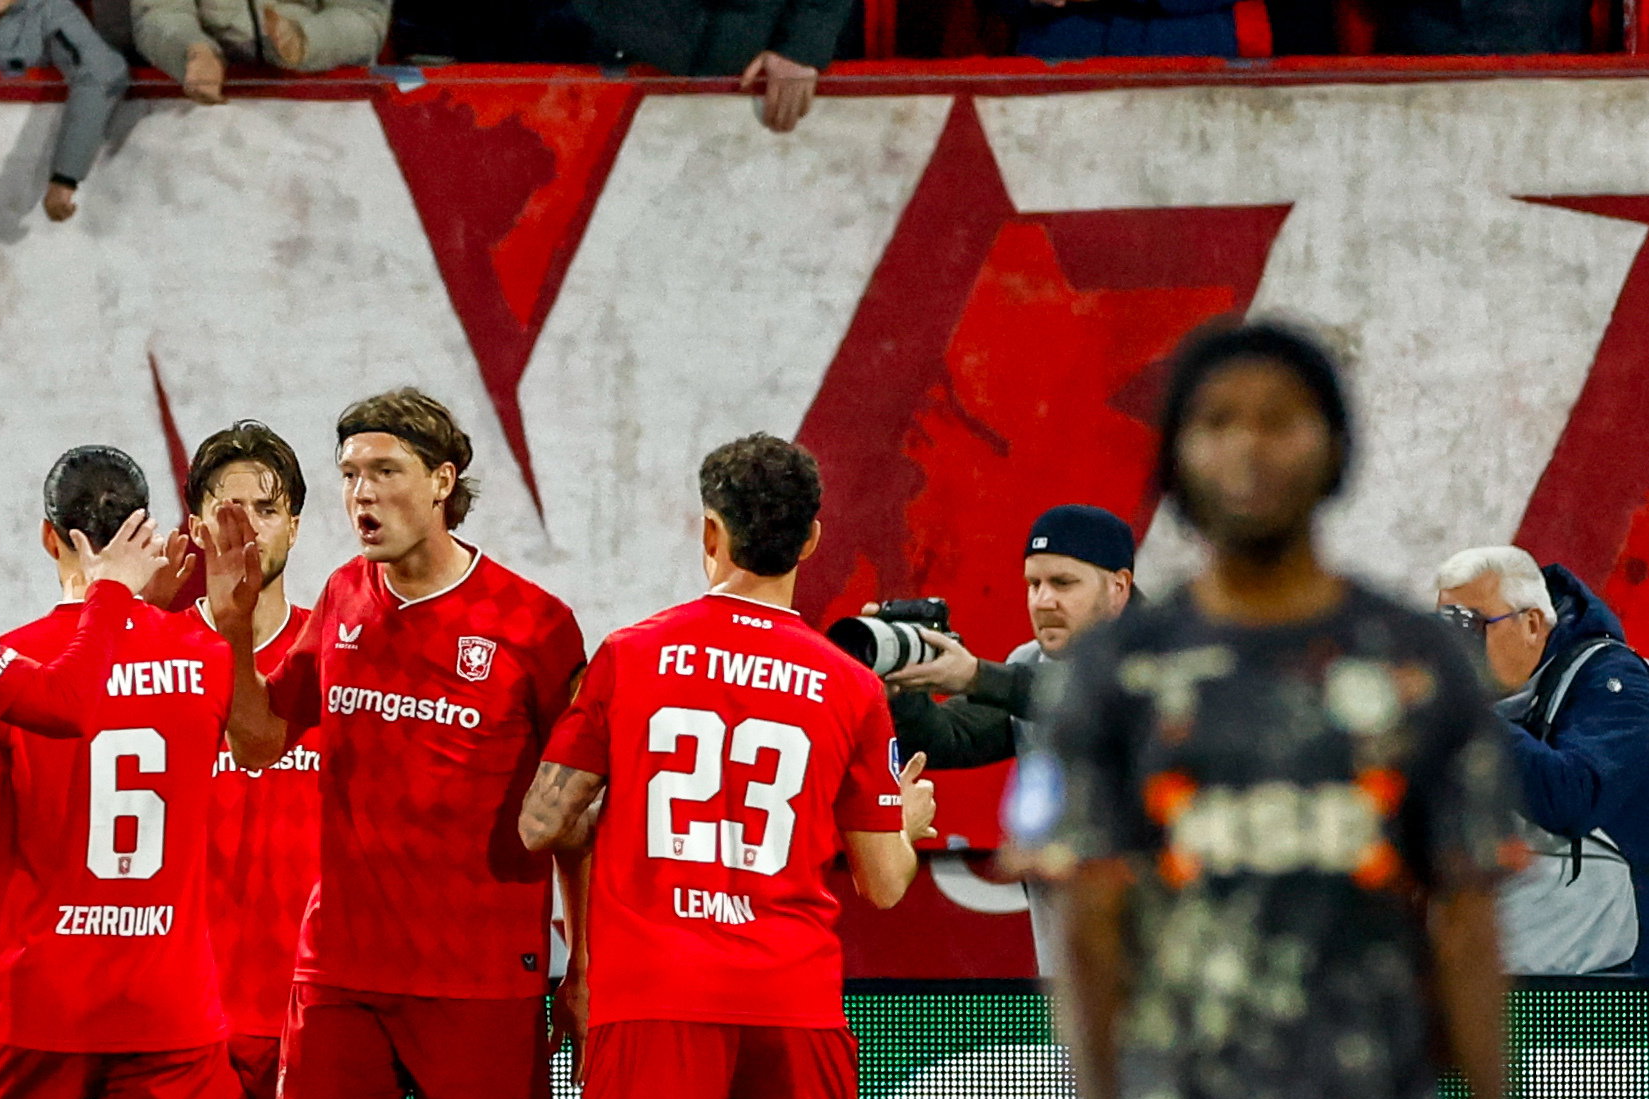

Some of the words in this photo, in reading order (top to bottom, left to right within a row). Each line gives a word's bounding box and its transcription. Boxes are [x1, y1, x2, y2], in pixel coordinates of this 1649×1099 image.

[731, 613, 774, 630] 1965
[658, 644, 697, 676] FC
[704, 646, 828, 703] TWENTE
[327, 684, 481, 729] ggmgastro
[86, 728, 167, 880] 6
[647, 706, 812, 877] 23
[55, 904, 174, 938] ZERROUKI
